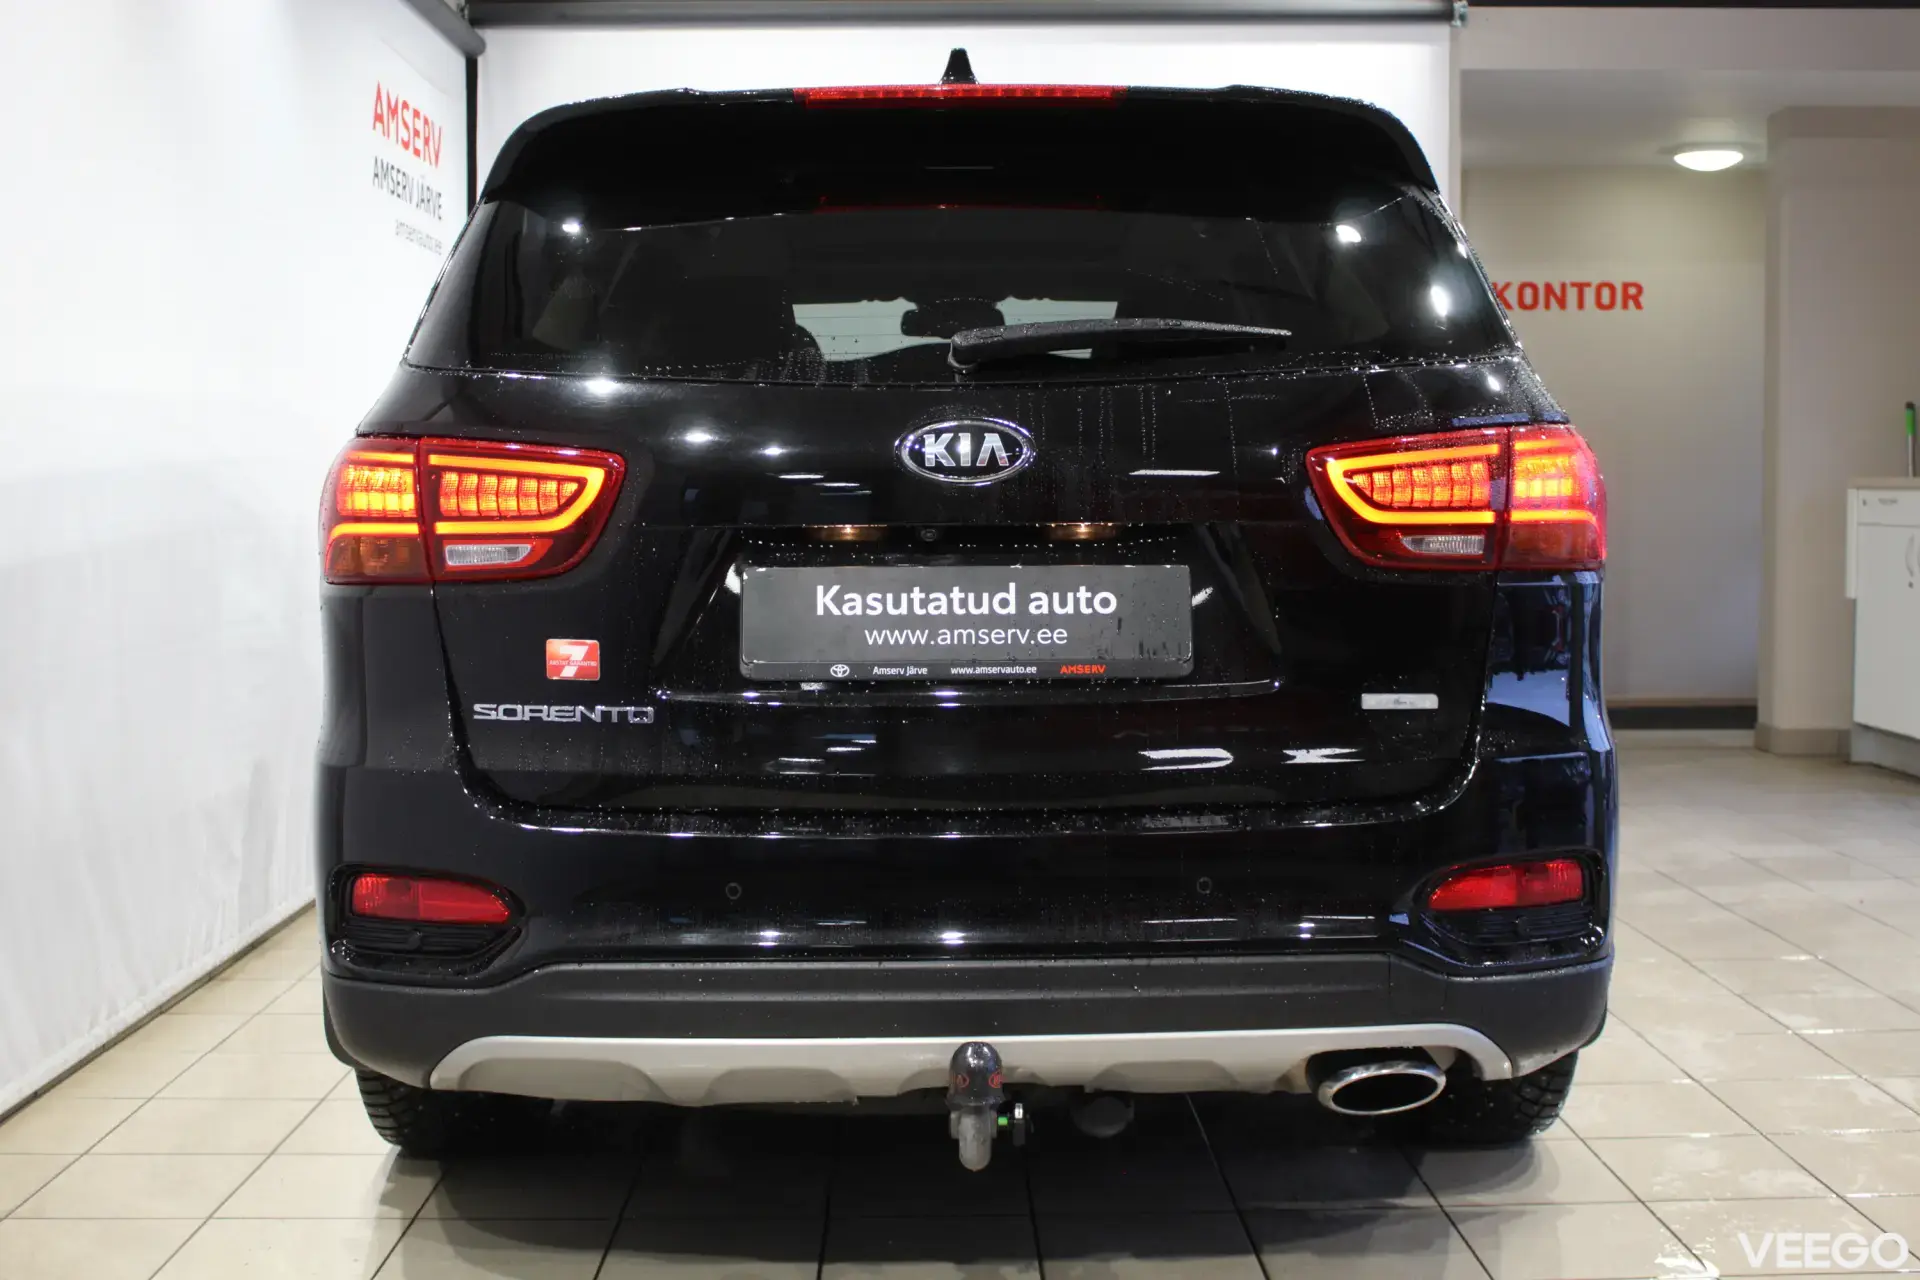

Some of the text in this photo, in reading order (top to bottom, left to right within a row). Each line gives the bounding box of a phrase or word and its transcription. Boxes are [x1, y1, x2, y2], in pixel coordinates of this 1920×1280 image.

[372, 79, 443, 169] AMSERV
[372, 155, 414, 205] AMSERV
[923, 432, 1009, 466] KIA
[815, 581, 1117, 616] Kasutatud auto
[864, 627, 1069, 646] www.amserv.ee
[872, 665, 928, 676] Amserv Järve
[950, 665, 1037, 675] www.amservauto.ee
[1060, 664, 1106, 674] AMSERV
[472, 703, 655, 724] SORENTO
